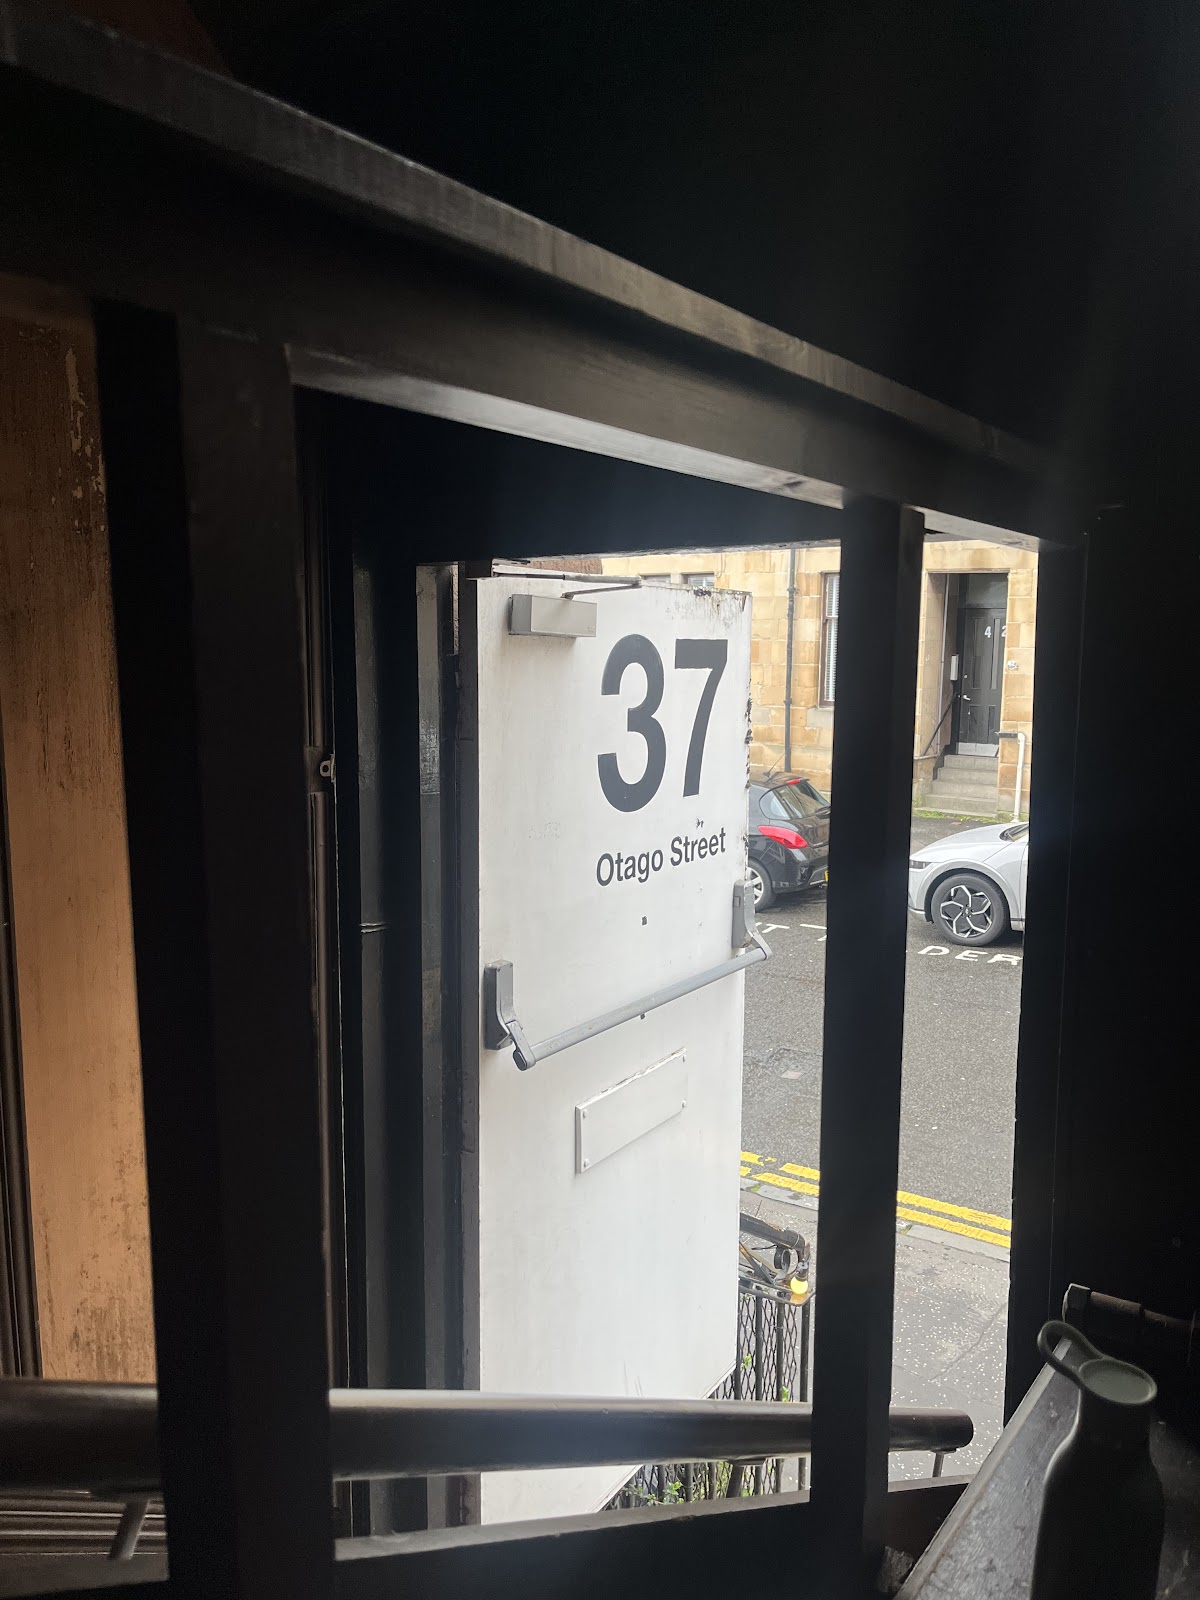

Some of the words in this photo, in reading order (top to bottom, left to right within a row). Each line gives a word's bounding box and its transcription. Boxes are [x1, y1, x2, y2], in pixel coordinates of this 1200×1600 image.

[598, 634, 728, 812] 37
[596, 850, 664, 887] Otago
[669, 827, 726, 867] Street
